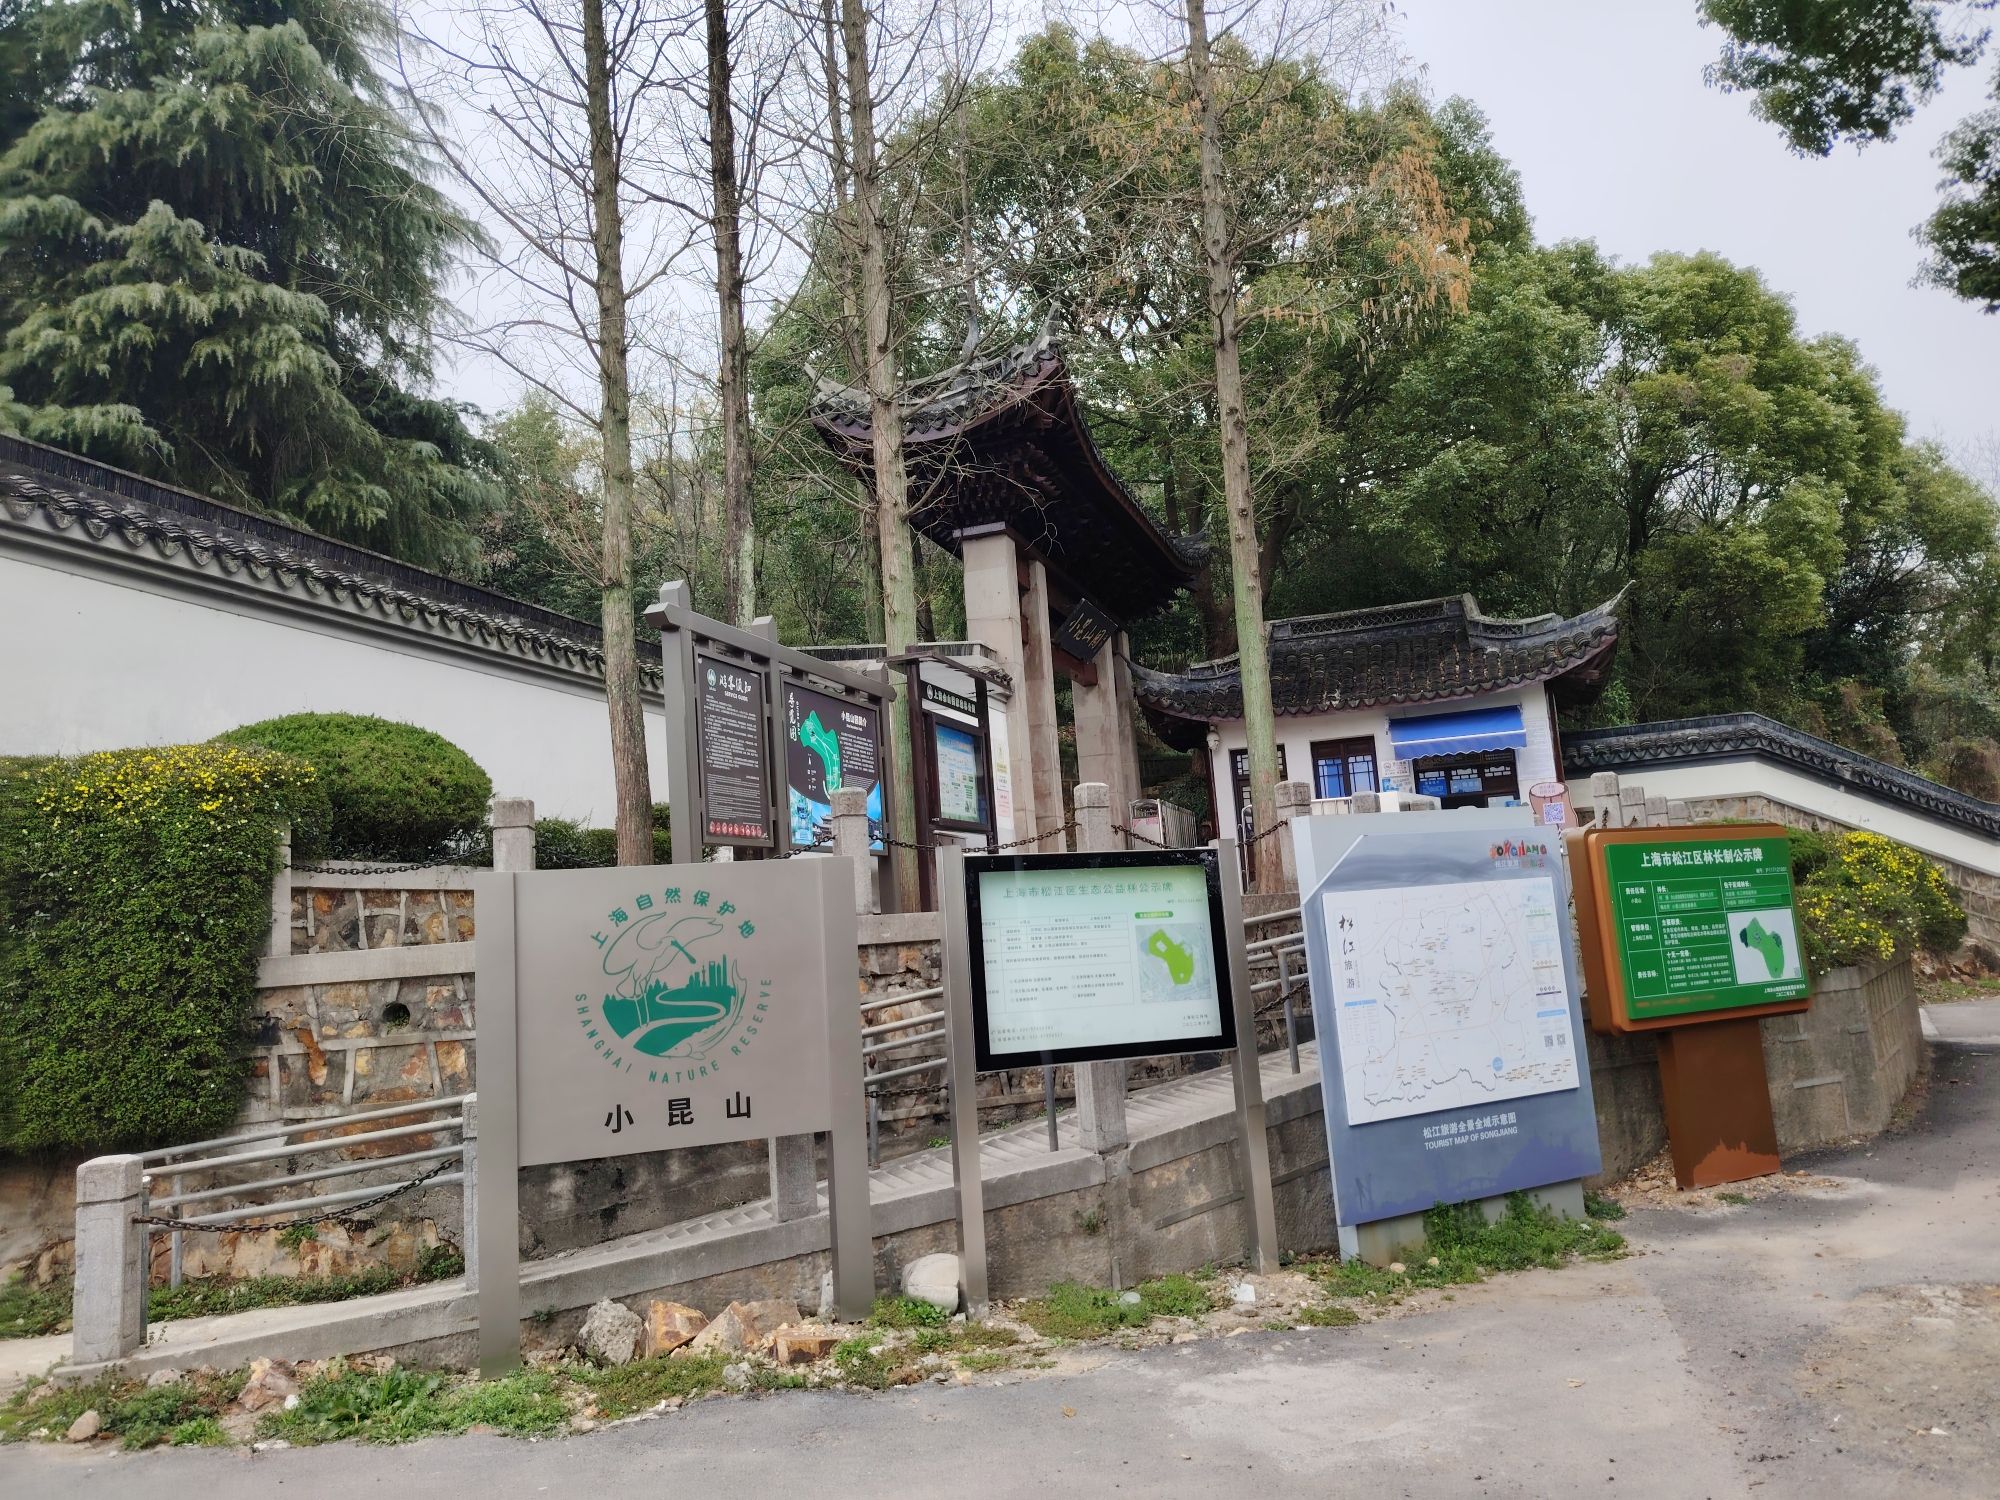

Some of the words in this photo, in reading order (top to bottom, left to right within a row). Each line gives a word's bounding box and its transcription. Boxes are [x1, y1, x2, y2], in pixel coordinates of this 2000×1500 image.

[1640, 847, 1764, 868] 上海市松江区林长制公示牌
[1002, 881, 1174, 899] 上海市松江区生态公益林公示牌
[1338, 914, 1357, 990] 松江旅游
[575, 993, 632, 1073] SHANGHAI
[648, 1060, 720, 1084] NATURE
[730, 978, 773, 1056] RESERVE
[604, 1091, 752, 1133] 小昆山
[1422, 1111, 1517, 1139] 松江旅游全景全域示意图
[1424, 1138, 1454, 1151] TOURIST
[1454, 1136, 1469, 1145] MAP
[1470, 1133, 1480, 1142] OF
[1480, 1126, 1518, 1140] SONGJIANG
